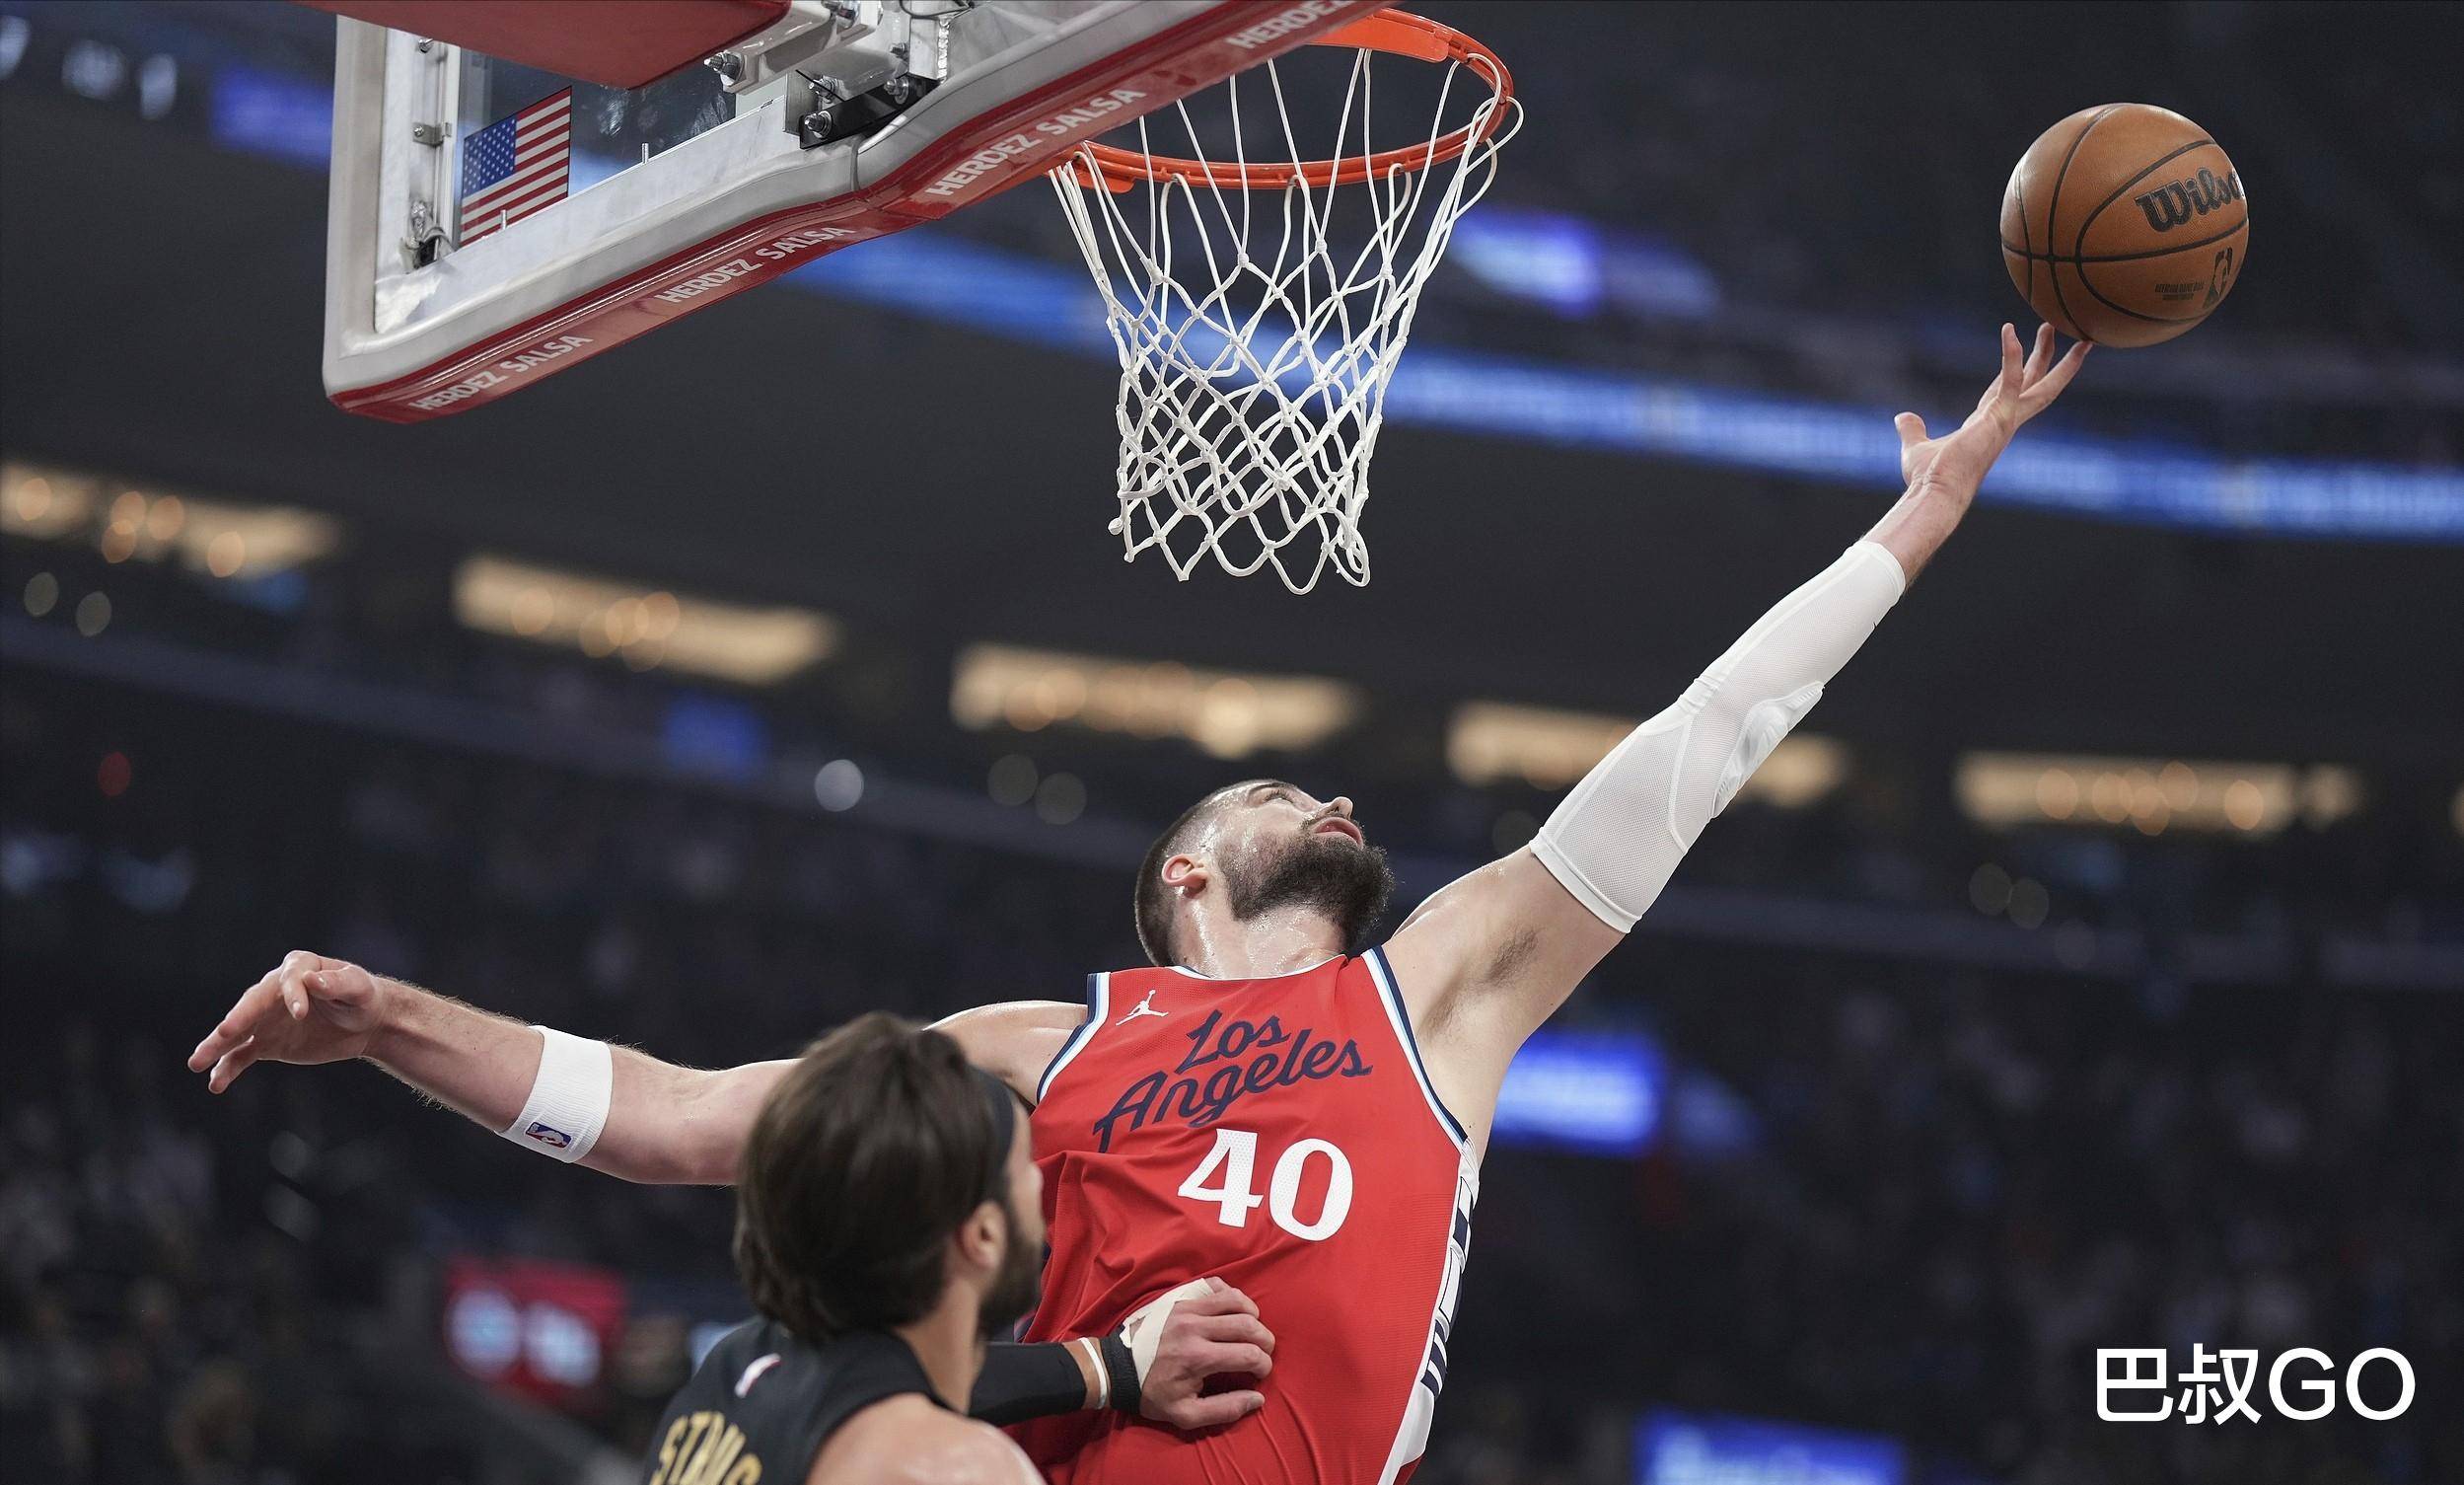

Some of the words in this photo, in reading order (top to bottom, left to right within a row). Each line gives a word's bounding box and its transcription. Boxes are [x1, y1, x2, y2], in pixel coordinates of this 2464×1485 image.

[925, 133, 1042, 195] HERDEZ
[1036, 89, 1147, 135] SALSA
[654, 259, 765, 303] HERDEZ
[756, 227, 857, 260] SALSA
[407, 370, 509, 410] HERDEZ
[499, 334, 594, 373] SALSA
[1174, 1008, 1292, 1075] Los
[1092, 1028, 1374, 1154] Angeles
[1177, 1128, 1354, 1242] 40
